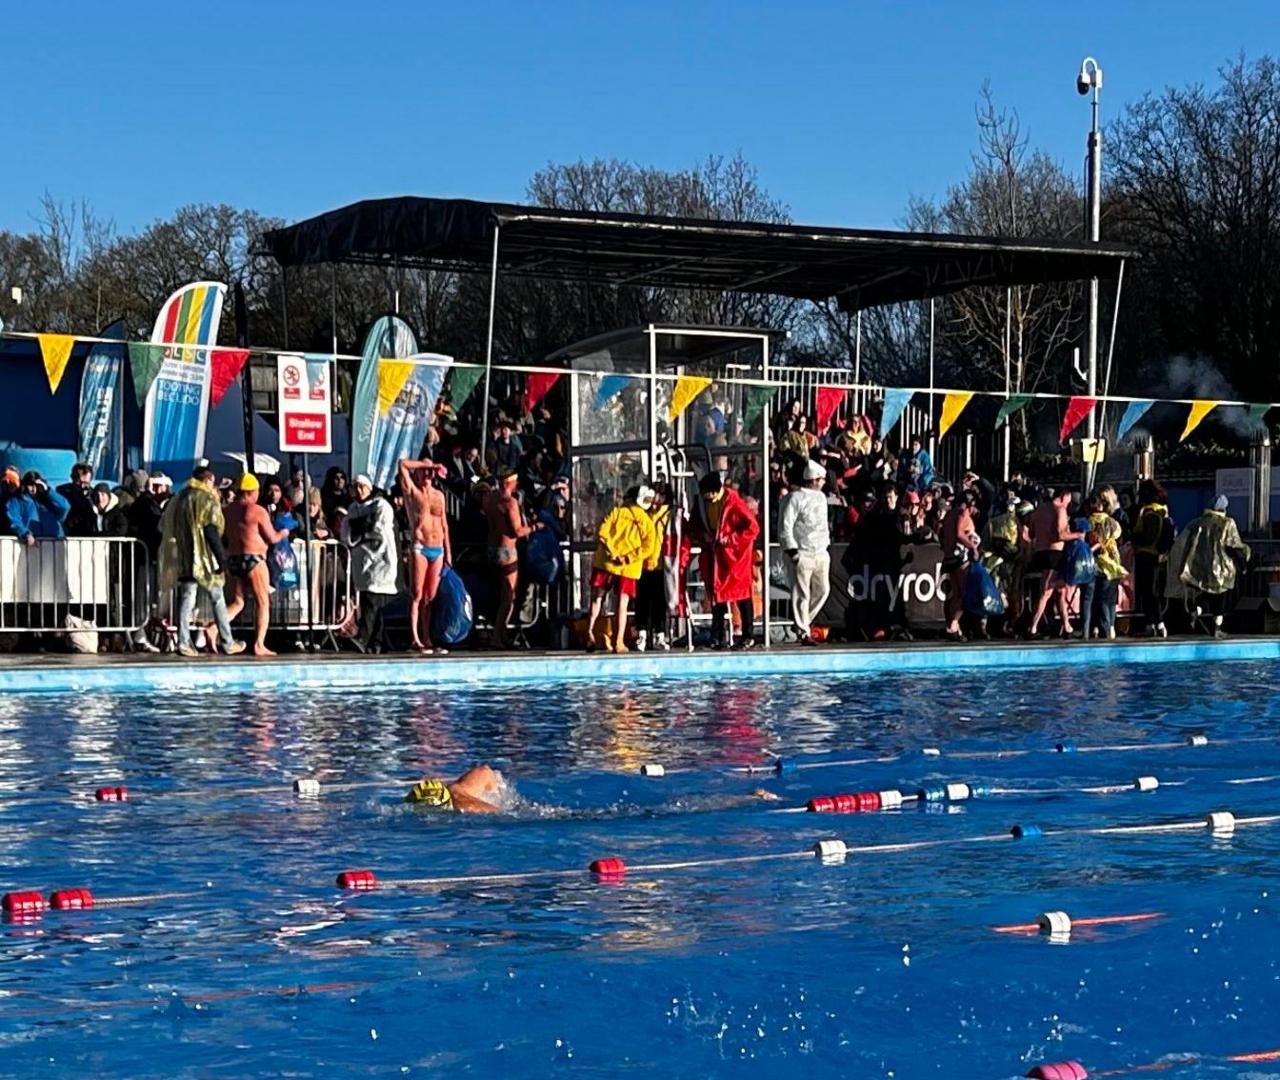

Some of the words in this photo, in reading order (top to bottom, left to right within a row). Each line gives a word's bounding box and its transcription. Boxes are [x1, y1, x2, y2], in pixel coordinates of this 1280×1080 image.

[158, 379, 202, 398] TOOTING
[288, 417, 323, 429] Shallow
[297, 430, 316, 441] End
[848, 563, 950, 612] dryrob
